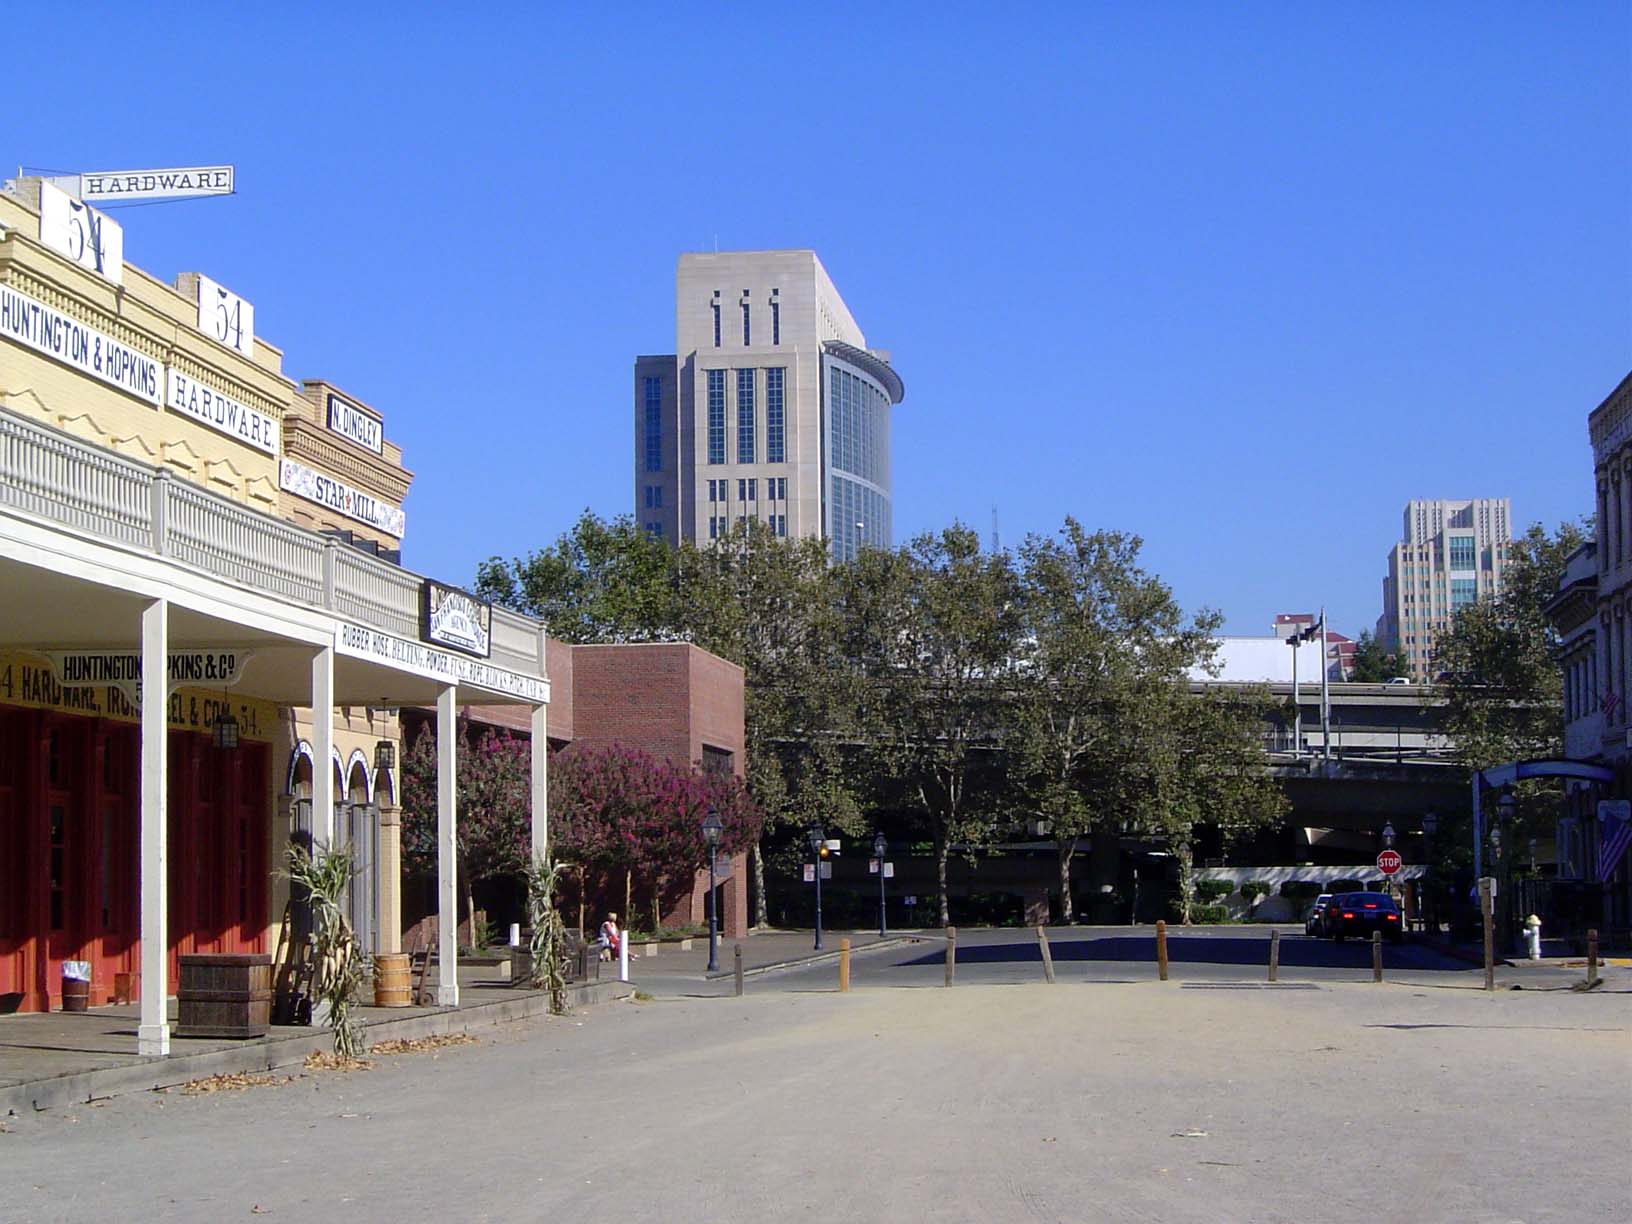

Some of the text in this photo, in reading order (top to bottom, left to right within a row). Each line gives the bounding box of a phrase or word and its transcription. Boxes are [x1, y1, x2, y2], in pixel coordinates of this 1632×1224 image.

[69, 200, 105, 275] 54
[2, 290, 89, 366] HUNTINGTON
[94, 336, 103, 373] &
[216, 287, 245, 351] 54
[333, 403, 380, 450] N. DINGLEY.
[315, 475, 346, 510] STAR
[343, 624, 369, 652] RUBBER
[63, 655, 142, 680] HUNTINGTON
[205, 654, 217, 680] &
[1380, 858, 1400, 868] STOP
